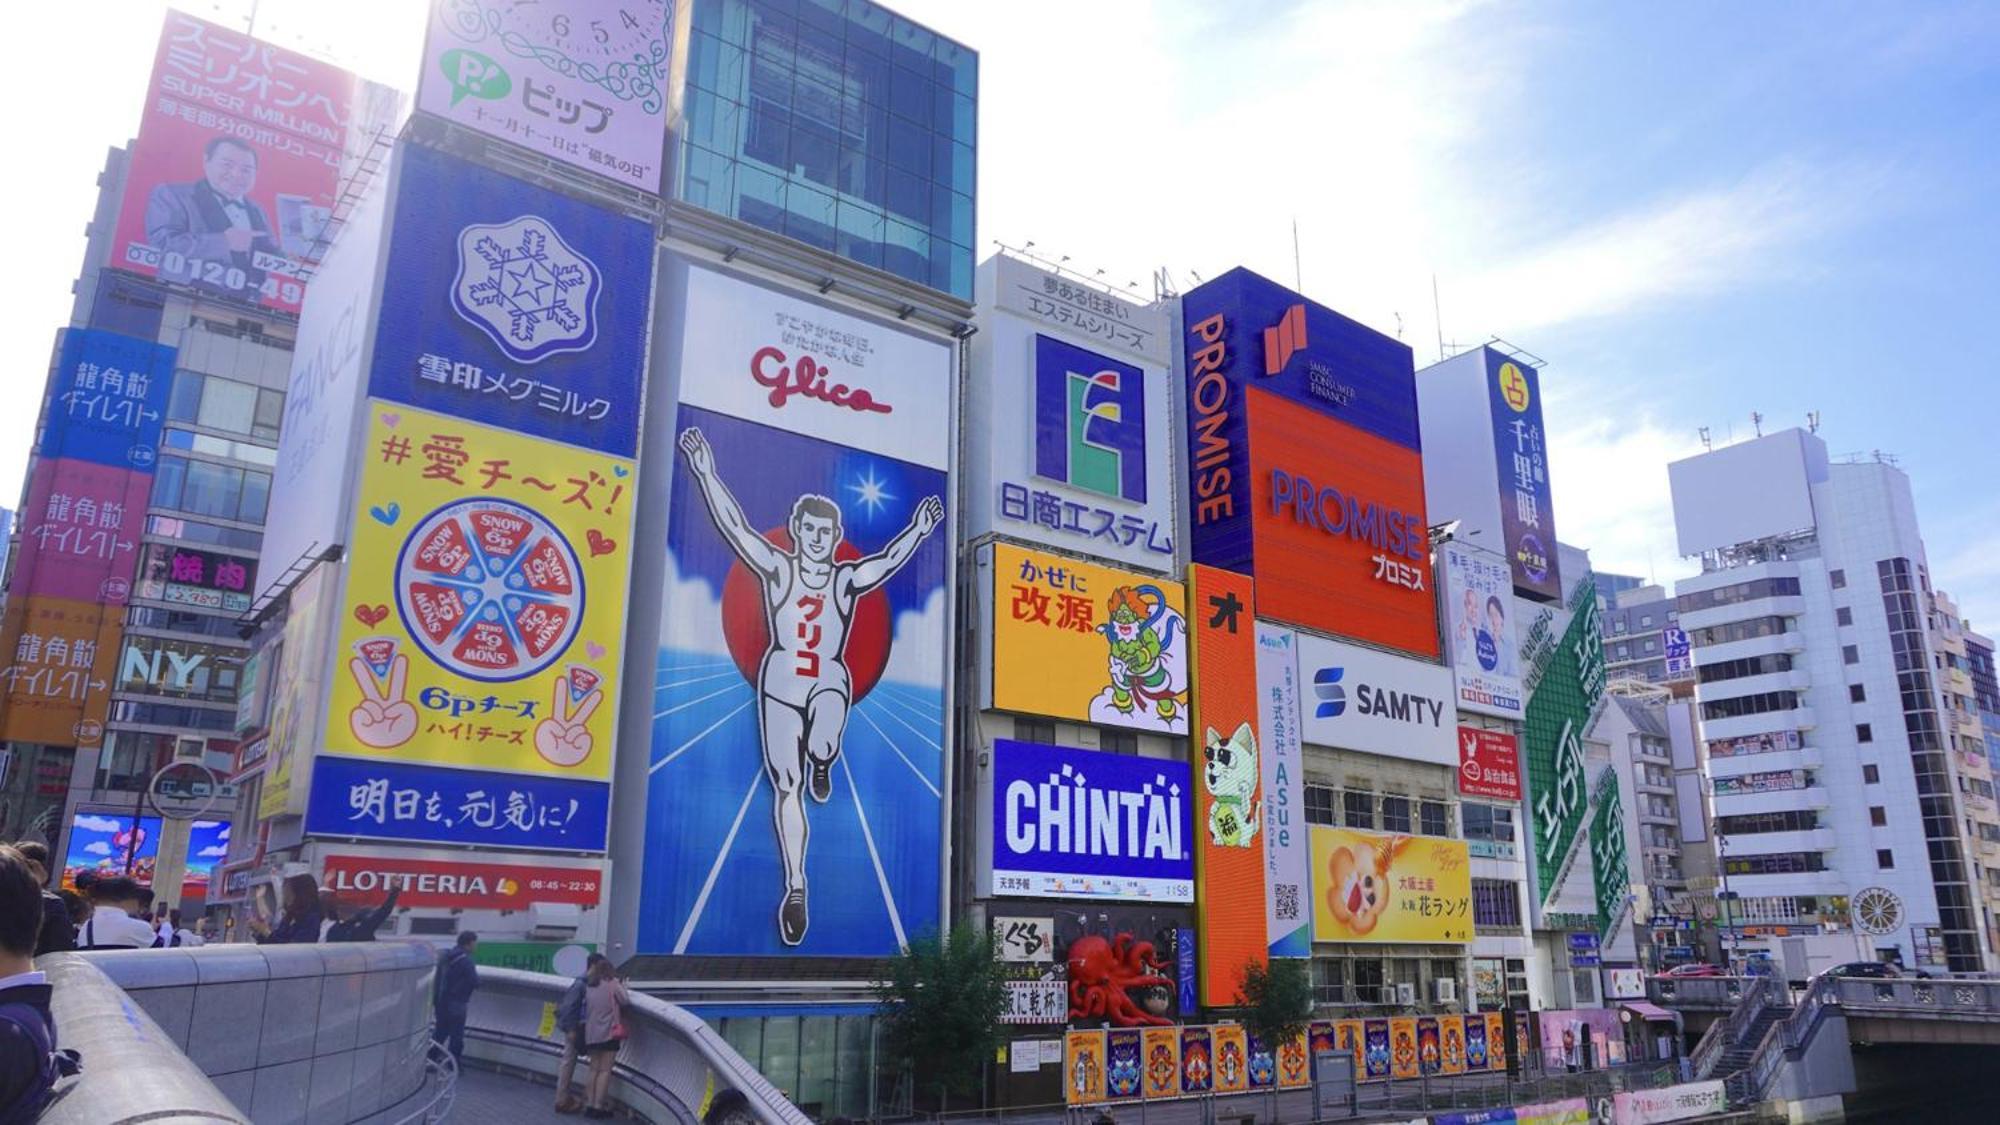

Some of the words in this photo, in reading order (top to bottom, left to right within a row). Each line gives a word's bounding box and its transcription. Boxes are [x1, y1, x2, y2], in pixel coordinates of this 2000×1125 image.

[552, 14, 570, 38] 6
[590, 20, 609, 45] 5
[619, 9, 640, 30] 4
[172, 16, 309, 76] スーパー
[161, 74, 246, 112] SUPER
[252, 105, 341, 143] MILLION
[522, 77, 614, 134] ピップ
[1042, 274, 1130, 321] 夢ある住まい
[1028, 296, 1145, 351] エステムシリーズ
[75, 361, 153, 400] 龍角散
[418, 353, 611, 421] 雪印メグミルク
[751, 346, 893, 414] Glico
[1310, 370, 1356, 400] CONSUMER
[1310, 382, 1348, 408] FINANCE
[1505, 366, 1525, 407] 占
[60, 390, 145, 429] ダイレクト
[1191, 313, 1232, 525] PROMISE
[47, 493, 127, 530] 龍角散
[479, 513, 525, 533] SNOW
[1002, 481, 1174, 556] 日商エステム
[1272, 467, 1423, 561] PROMISE
[31, 523, 118, 561] ダイレクト
[420, 525, 454, 563] SNOW
[172, 552, 246, 591] 焼肉
[543, 547, 570, 586] SNOW
[1020, 558, 1089, 593] かぜに
[1372, 554, 1426, 592] プロミス
[413, 591, 442, 634] SNOW
[1011, 583, 1096, 634] 改源
[1208, 591, 1244, 634] オ
[17, 633, 99, 669] 龍角散
[533, 613, 564, 652] SNOW
[795, 592, 828, 680] グリコ
[123, 645, 208, 689] NY
[463, 647, 508, 664] SNOW
[0, 666, 91, 701] ダイレクト
[1357, 683, 1444, 728] SAMTY
[426, 722, 527, 746] ハイ!チーズ
[1538, 718, 1585, 840] エイブル
[348, 778, 580, 834] 明日を、元気に!
[1275, 761, 1290, 848] Asue
[1218, 814, 1239, 838] 福
[336, 871, 488, 894] LOTTERIA
[1005, 922, 1043, 956] くくる
